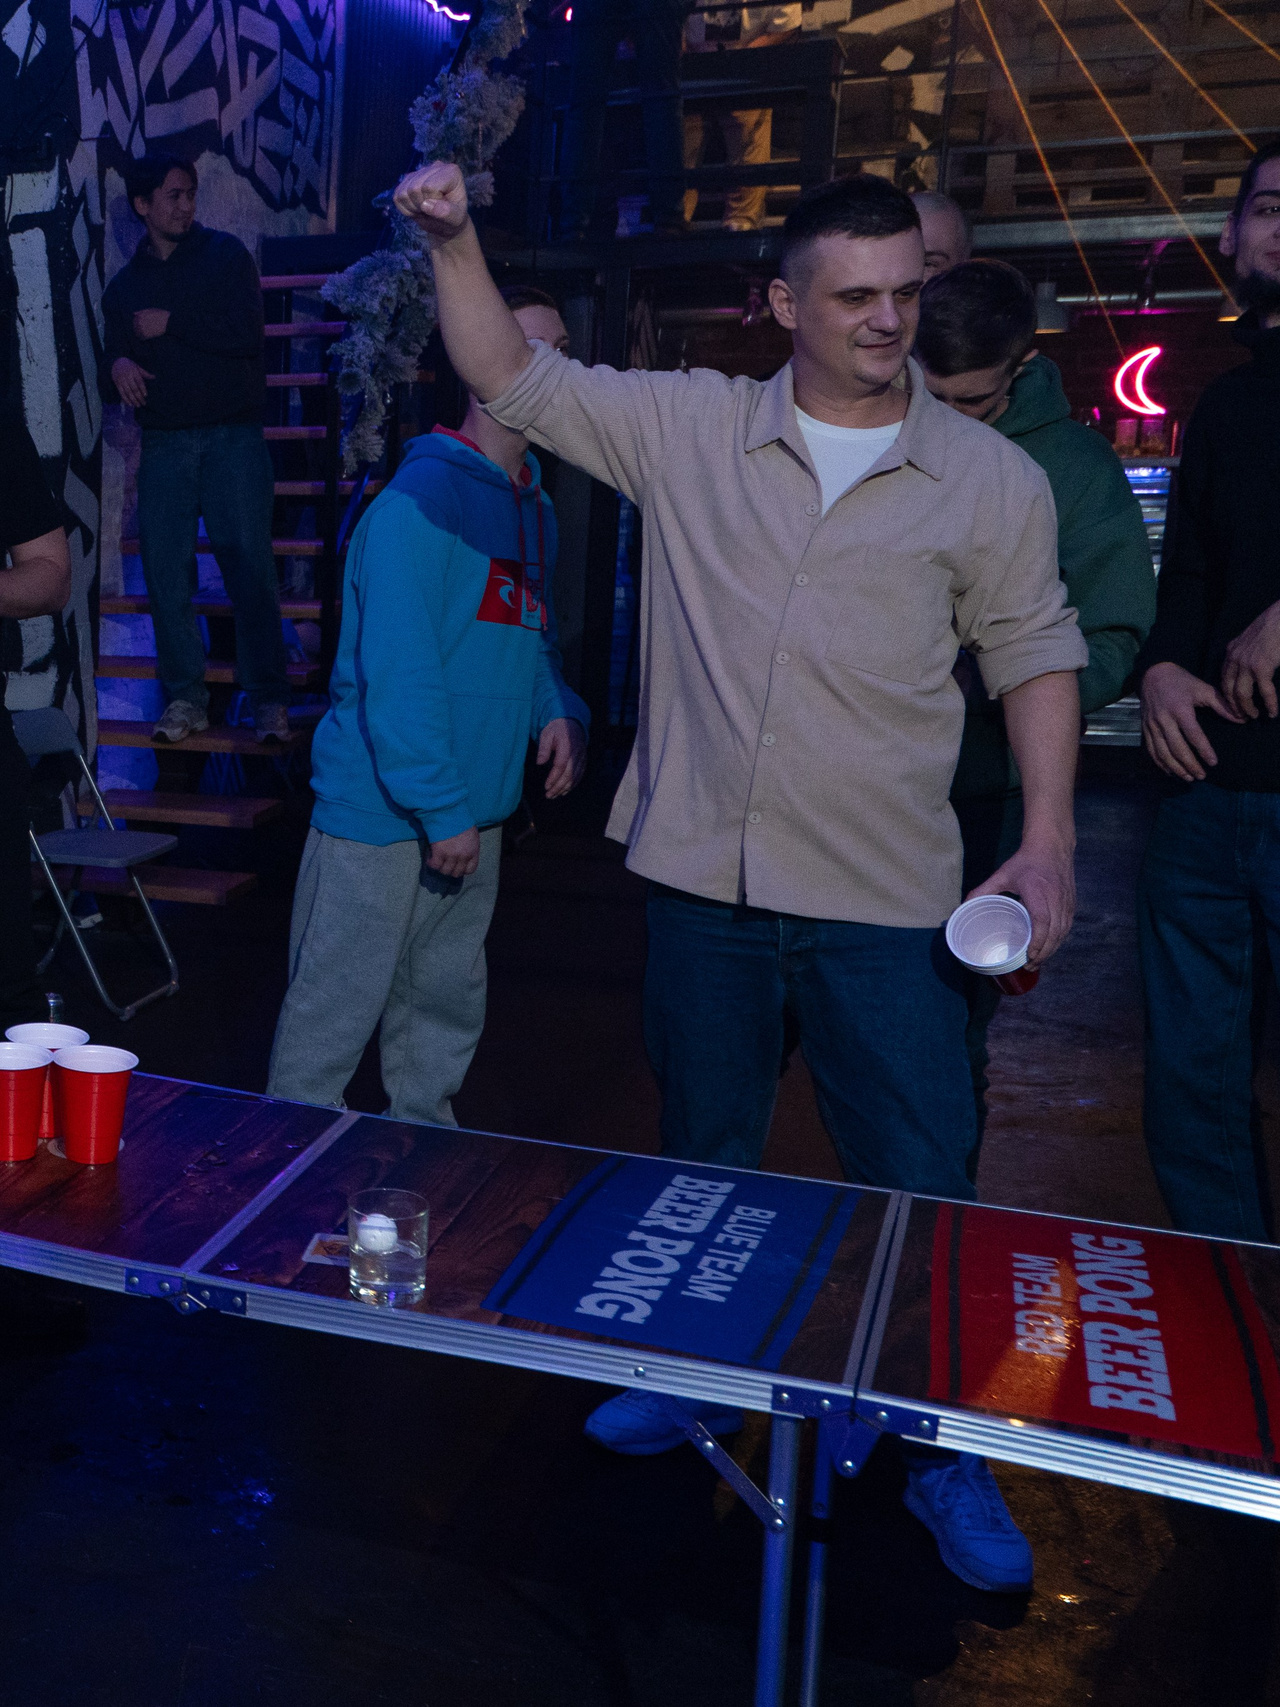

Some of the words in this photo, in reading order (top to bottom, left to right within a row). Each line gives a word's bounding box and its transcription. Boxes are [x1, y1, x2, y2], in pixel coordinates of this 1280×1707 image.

[636, 1174, 736, 1234] BEER
[713, 1204, 777, 1250] BLUE
[574, 1230, 695, 1325] PONG
[680, 1248, 752, 1302] TEAM
[1011, 1252, 1062, 1307] TEAM
[1070, 1232, 1159, 1322] PONG
[1013, 1308, 1070, 1360] RED
[1081, 1320, 1177, 1422] BEER
